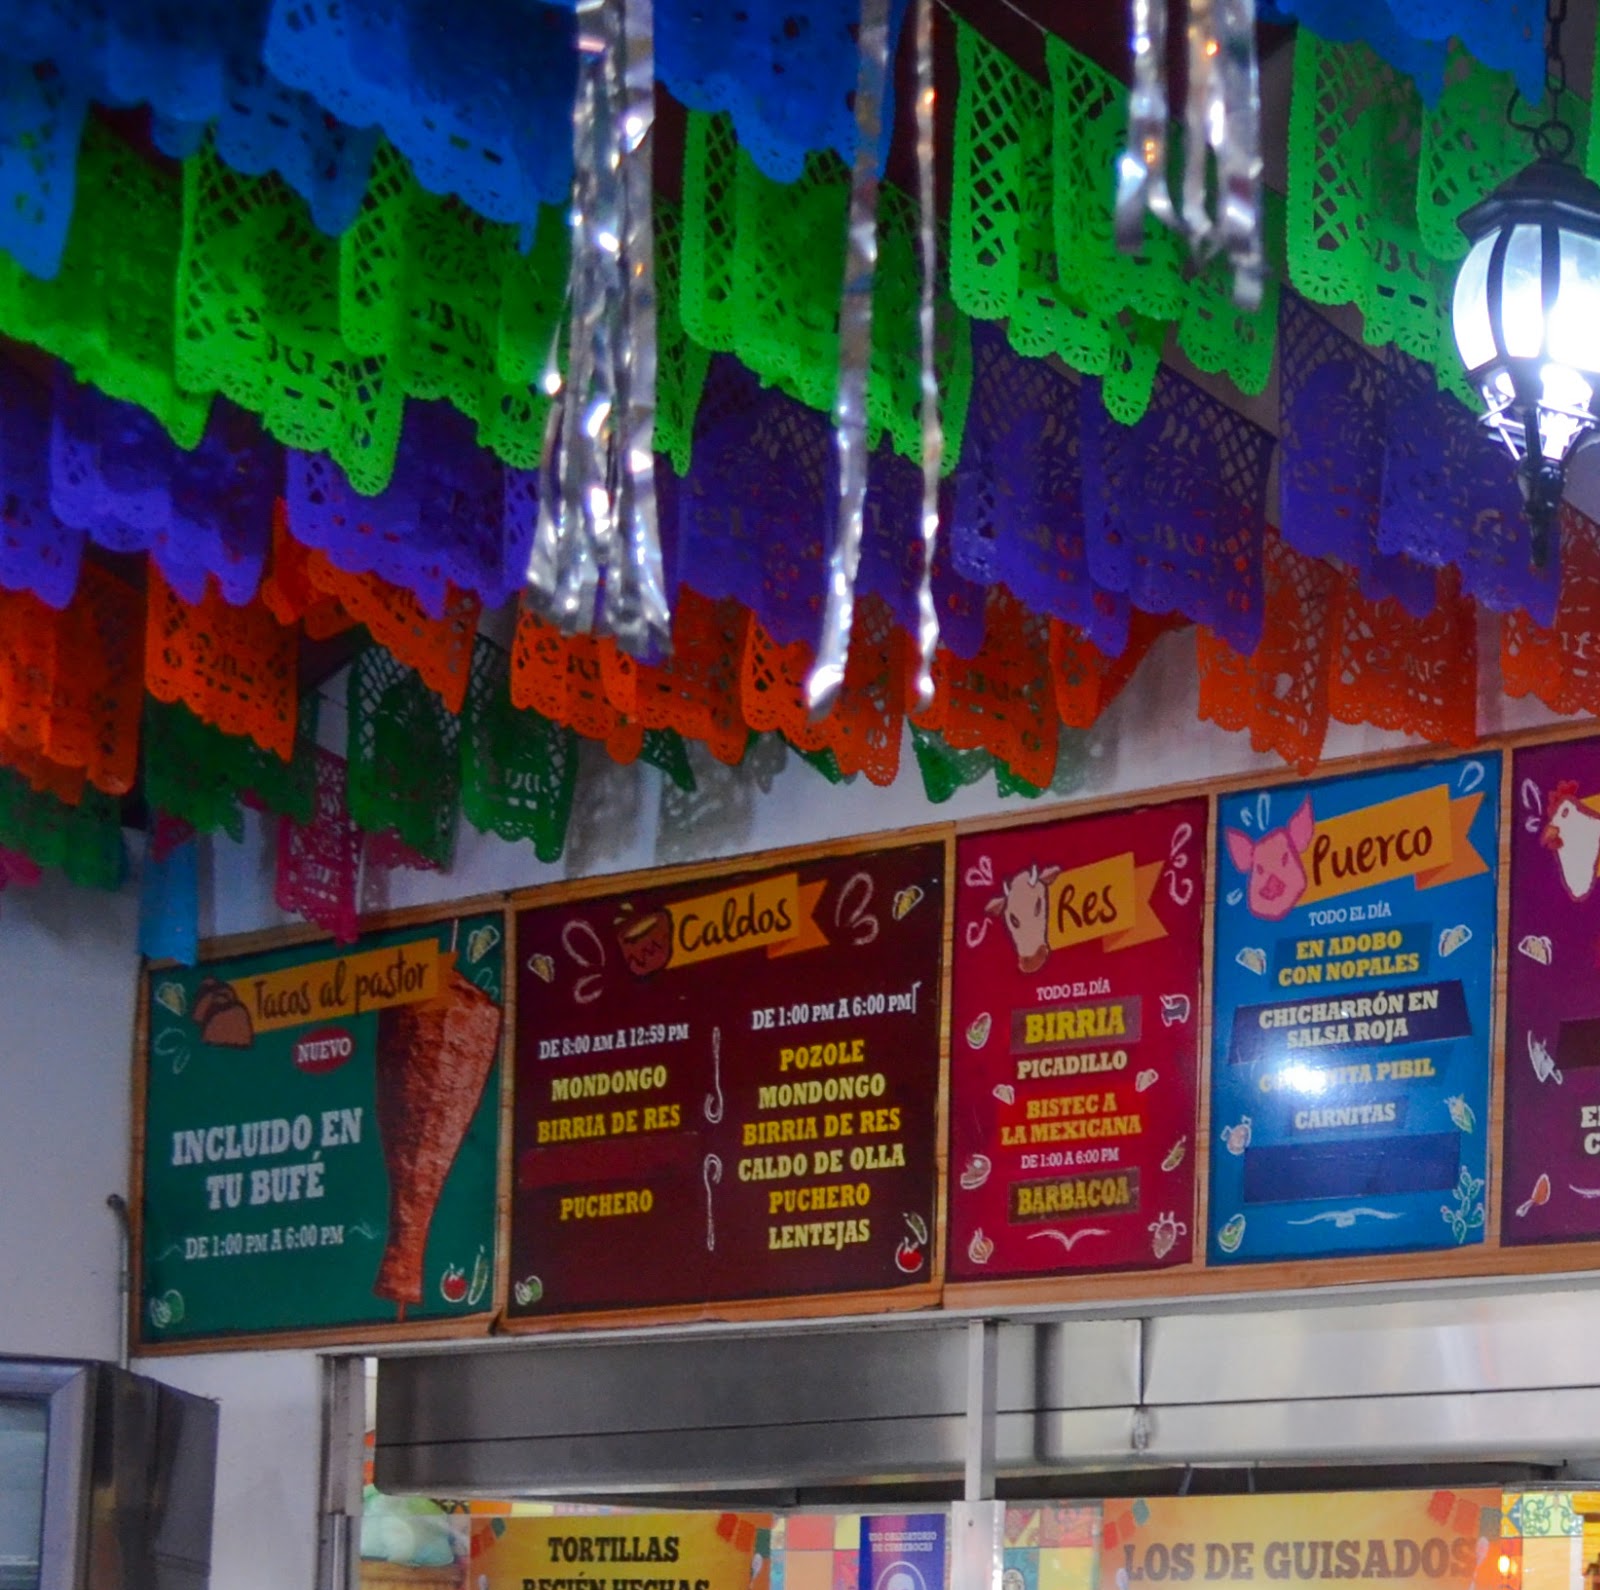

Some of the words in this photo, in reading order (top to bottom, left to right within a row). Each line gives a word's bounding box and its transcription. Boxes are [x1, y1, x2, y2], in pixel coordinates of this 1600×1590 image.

[1312, 825, 1433, 886] Puerco
[678, 898, 792, 952] Caldos
[1056, 883, 1119, 933] Res
[1296, 938, 1325, 960] EN
[1328, 930, 1403, 957] ADOBO
[254, 980, 311, 1021] Tacos
[320, 961, 345, 1007] al
[355, 950, 430, 1016] pastor
[1278, 961, 1322, 987] CON
[1325, 952, 1420, 983] NOPALES
[1024, 1005, 1126, 1046] BIRRIA
[1258, 989, 1405, 1030] CHICHARRÓN
[1408, 989, 1439, 1012] EN
[297, 1037, 351, 1063] NUEVO
[1287, 1022, 1351, 1050] SALSA
[1353, 1017, 1410, 1046] ROJA
[779, 1039, 865, 1072] POZOLE
[1017, 1050, 1128, 1081] PICADILLO
[1376, 1057, 1436, 1082] PIBIL
[551, 1065, 668, 1101] MONDONGO
[758, 1072, 886, 1109] MONDONGO
[1026, 1093, 1098, 1119] BISTEC
[1101, 1092, 1118, 1113] A
[1294, 1102, 1397, 1130] CARNITAS
[172, 1114, 312, 1166] INCLUIDO
[321, 1107, 363, 1147] EN
[537, 1111, 607, 1144] BIRRIA
[611, 1108, 640, 1135] DE
[644, 1104, 681, 1131] RES
[742, 1114, 818, 1146] BIRRIA
[823, 1112, 854, 1137] DE
[859, 1107, 902, 1134] RES
[1000, 1122, 1029, 1146] LA
[1030, 1115, 1143, 1144] MEXICANA
[738, 1151, 808, 1182] CALDO
[813, 1149, 844, 1174] DE
[850, 1143, 906, 1171] OLLA
[206, 1172, 243, 1210] TU
[250, 1151, 325, 1205] BUFÉ
[768, 1182, 871, 1214] PUCHERO
[1017, 1179, 1130, 1216] BARBACOA
[559, 1189, 654, 1221] PUCHERO
[185, 1236, 208, 1260] DE
[212, 1233, 243, 1256] 1:00
[246, 1233, 269, 1254] PM
[271, 1229, 284, 1251] A
[285, 1225, 318, 1249] 6:00
[320, 1225, 345, 1246] PM
[768, 1218, 871, 1250] LENTEJAS
[548, 1536, 679, 1562] TORTILLAS
[1124, 1543, 1195, 1581] LOS
[1205, 1541, 1254, 1580] DE
[1263, 1537, 1477, 1579] GUISADOS
